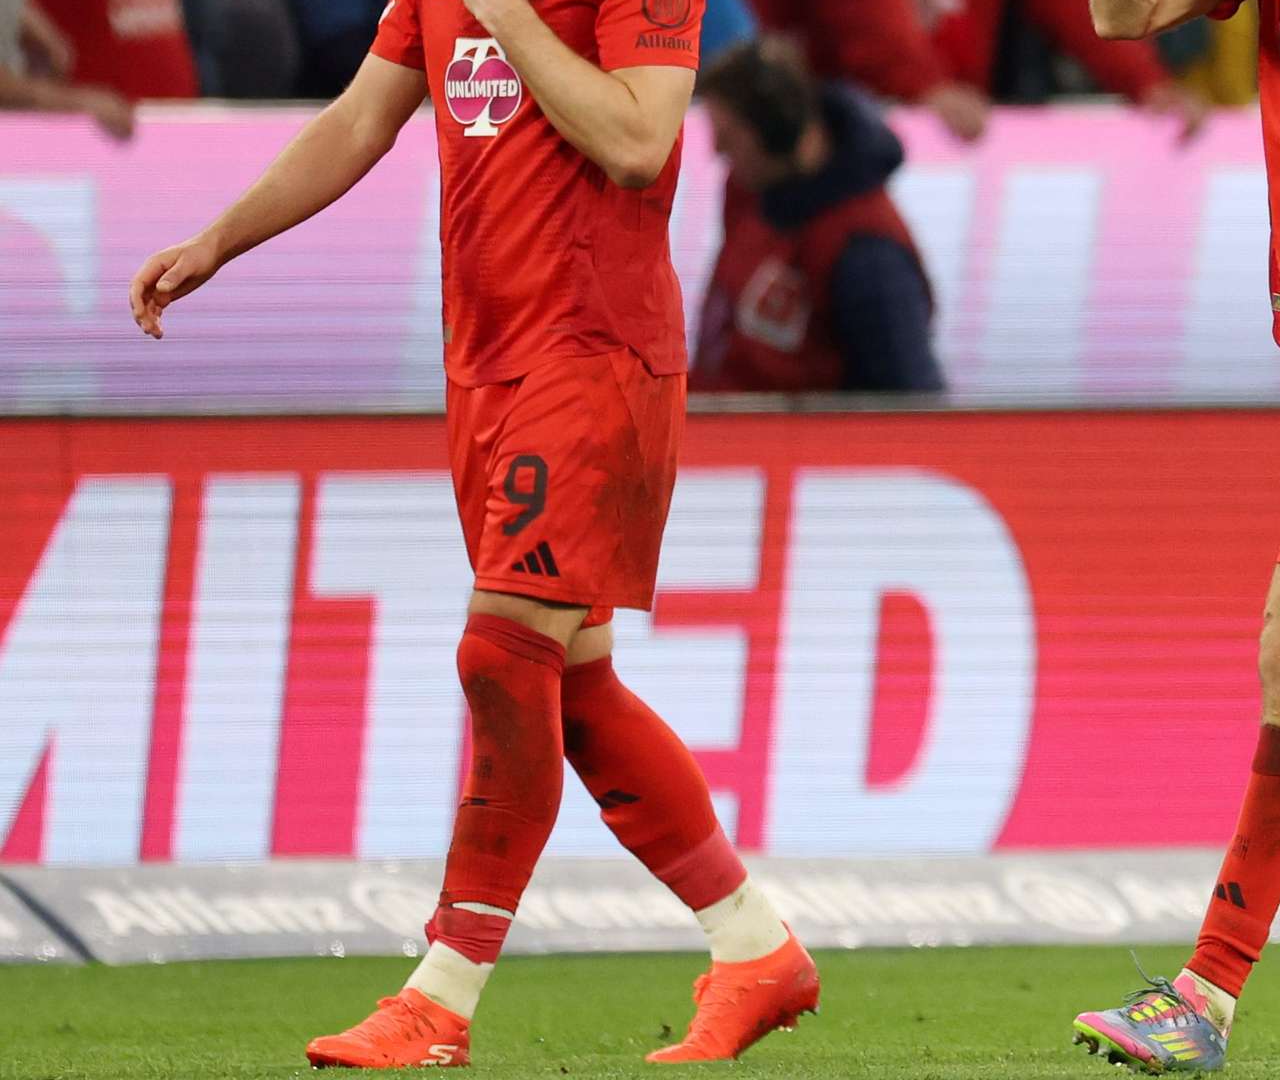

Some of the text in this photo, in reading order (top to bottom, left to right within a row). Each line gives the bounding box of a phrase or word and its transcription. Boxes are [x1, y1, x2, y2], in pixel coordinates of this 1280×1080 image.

[634, 33, 693, 52] Allianz
[447, 79, 519, 98] UNLIMITED
[503, 454, 549, 537] 9
